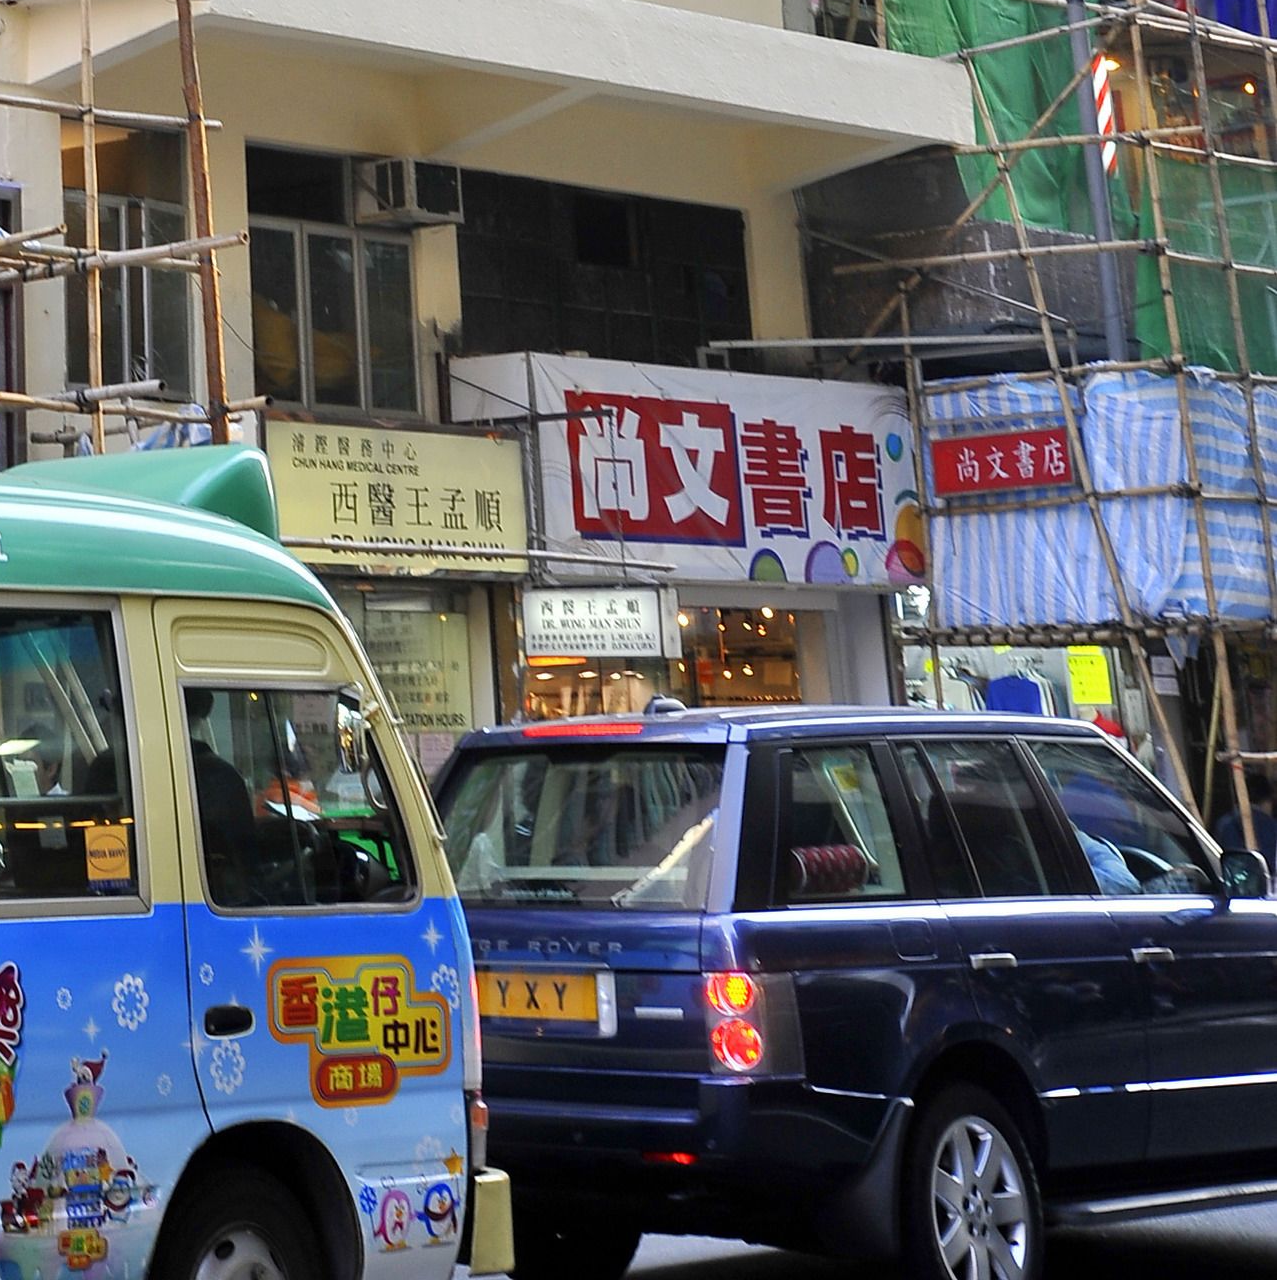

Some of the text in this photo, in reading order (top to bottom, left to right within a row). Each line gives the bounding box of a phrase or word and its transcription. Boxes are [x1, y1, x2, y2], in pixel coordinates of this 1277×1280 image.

[291, 456, 420, 477] CHUN HANG MEDICAL CENTRE
[578, 403, 886, 540] 尚文書店
[956, 437, 1066, 483] 尚文書店
[329, 481, 504, 533] 西醫王孟順
[560, 618, 586, 630] WONG
[589, 618, 612, 630] MAN
[614, 618, 642, 630] SHUN
[527, 939, 623, 955] ROVER
[329, 1062, 383, 1092] 商場
